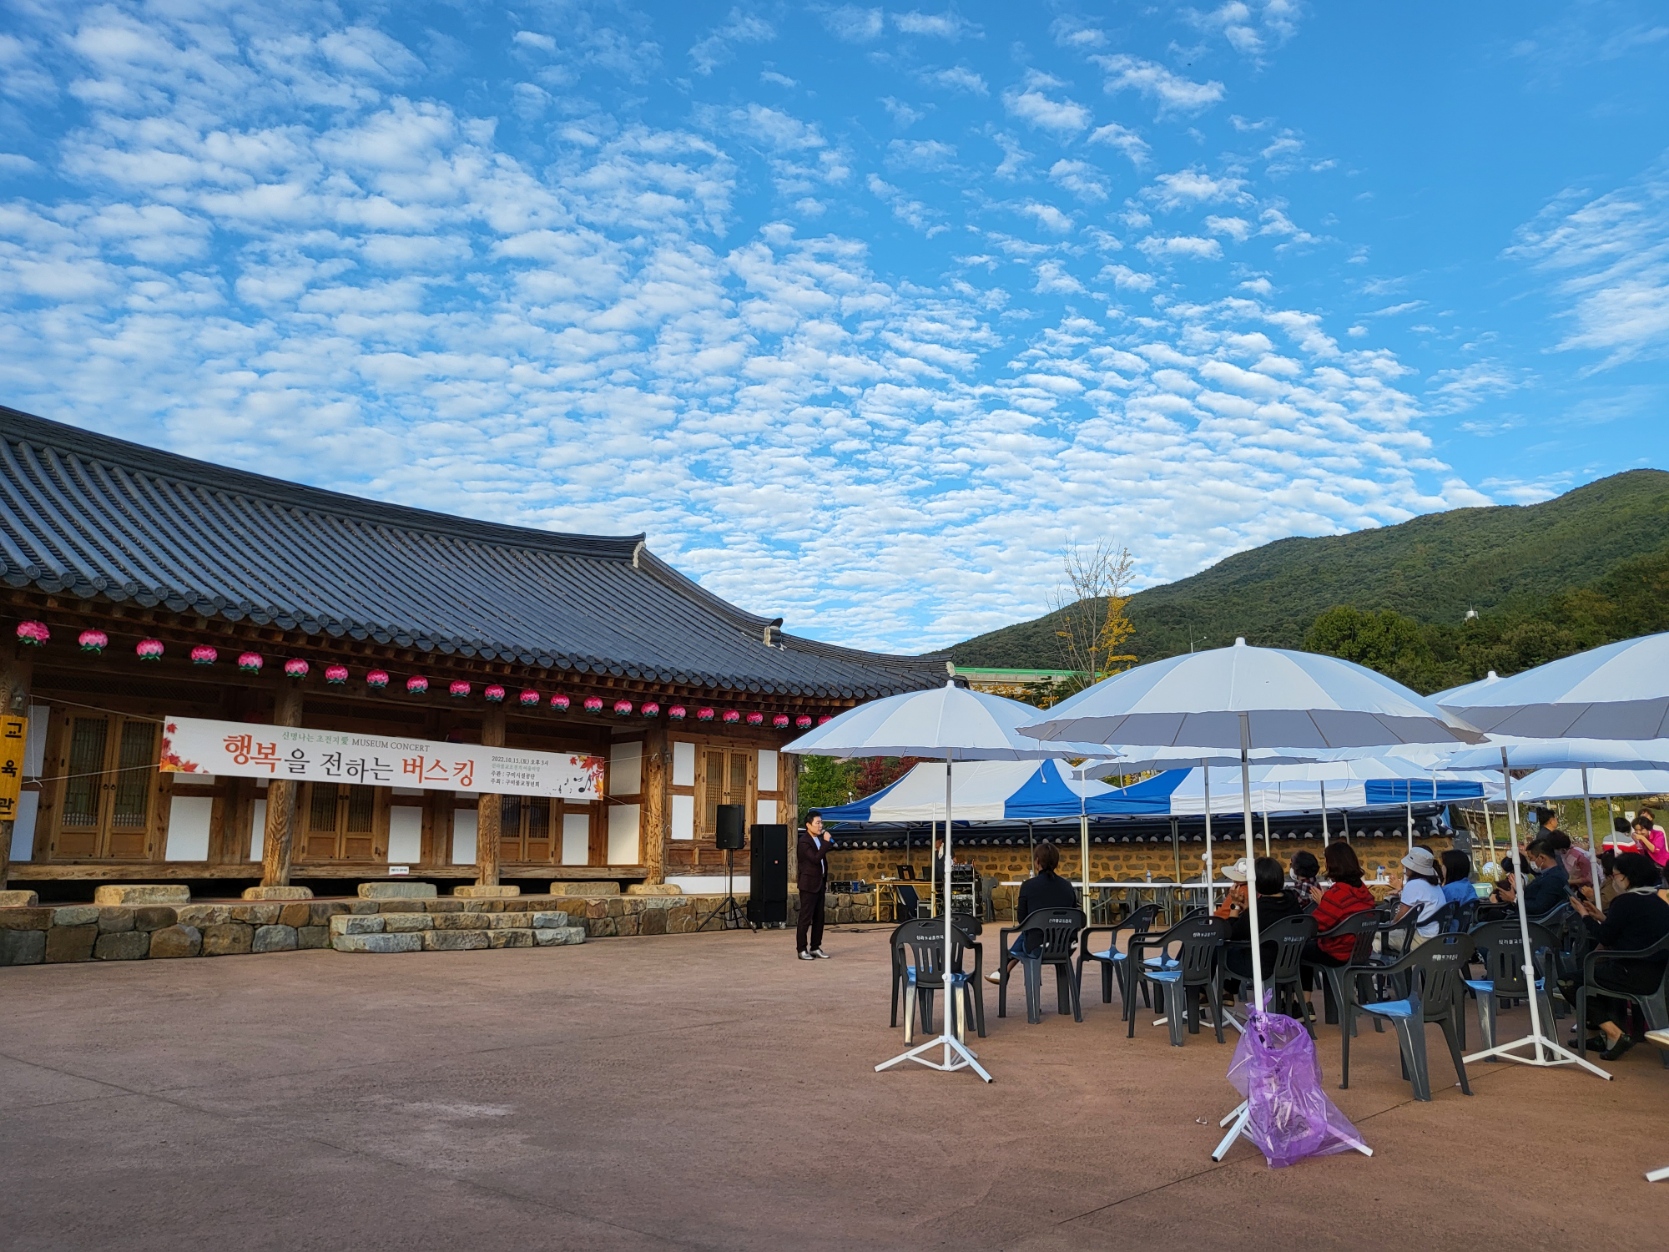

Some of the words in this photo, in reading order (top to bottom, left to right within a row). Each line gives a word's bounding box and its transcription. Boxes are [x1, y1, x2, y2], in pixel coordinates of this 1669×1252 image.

[223, 733, 311, 774] 행복을
[320, 751, 394, 783] 전하는
[402, 754, 475, 787] 버스킹
[282, 731, 314, 743] 신명나는
[352, 738, 389, 749] MUSEUM
[390, 741, 430, 752] CONCERT
